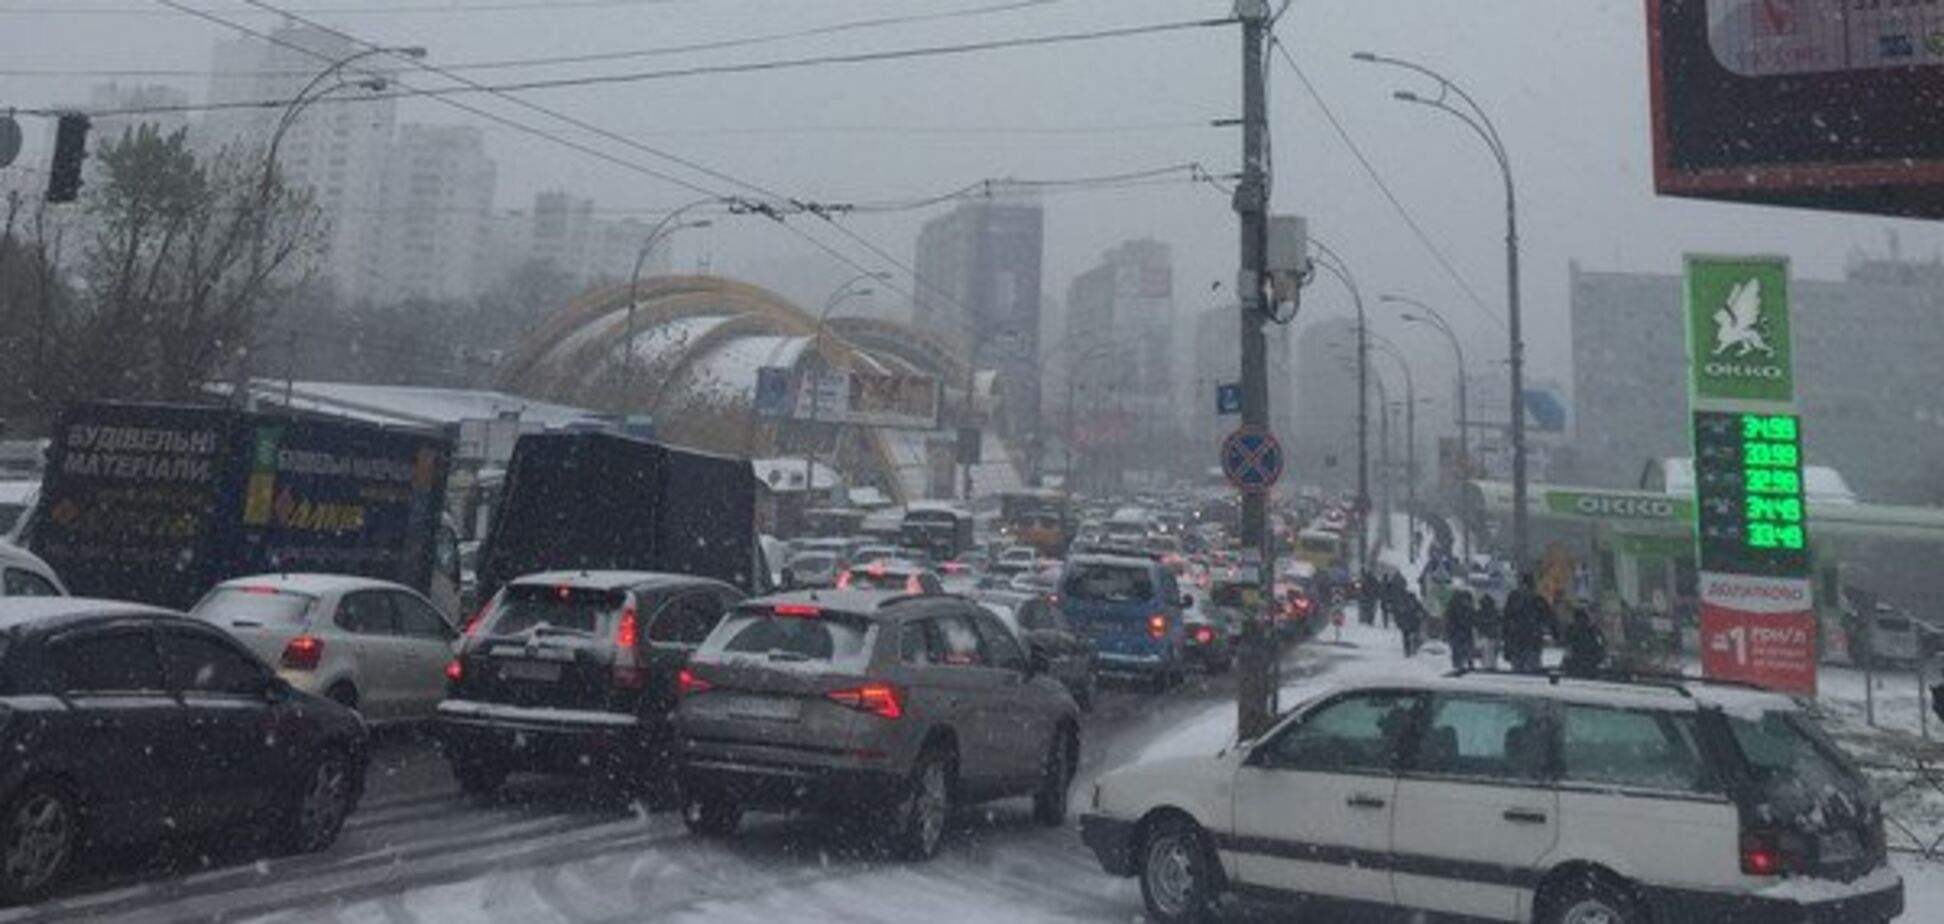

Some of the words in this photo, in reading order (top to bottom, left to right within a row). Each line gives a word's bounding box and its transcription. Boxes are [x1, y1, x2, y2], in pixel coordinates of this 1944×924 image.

[1705, 362, 1782, 378] OKKO
[67, 425, 216, 453] БУДІВЕЛЬНІ
[64, 452, 212, 483] МАТЕРІАЛИ
[1577, 496, 1673, 517] OKKO
